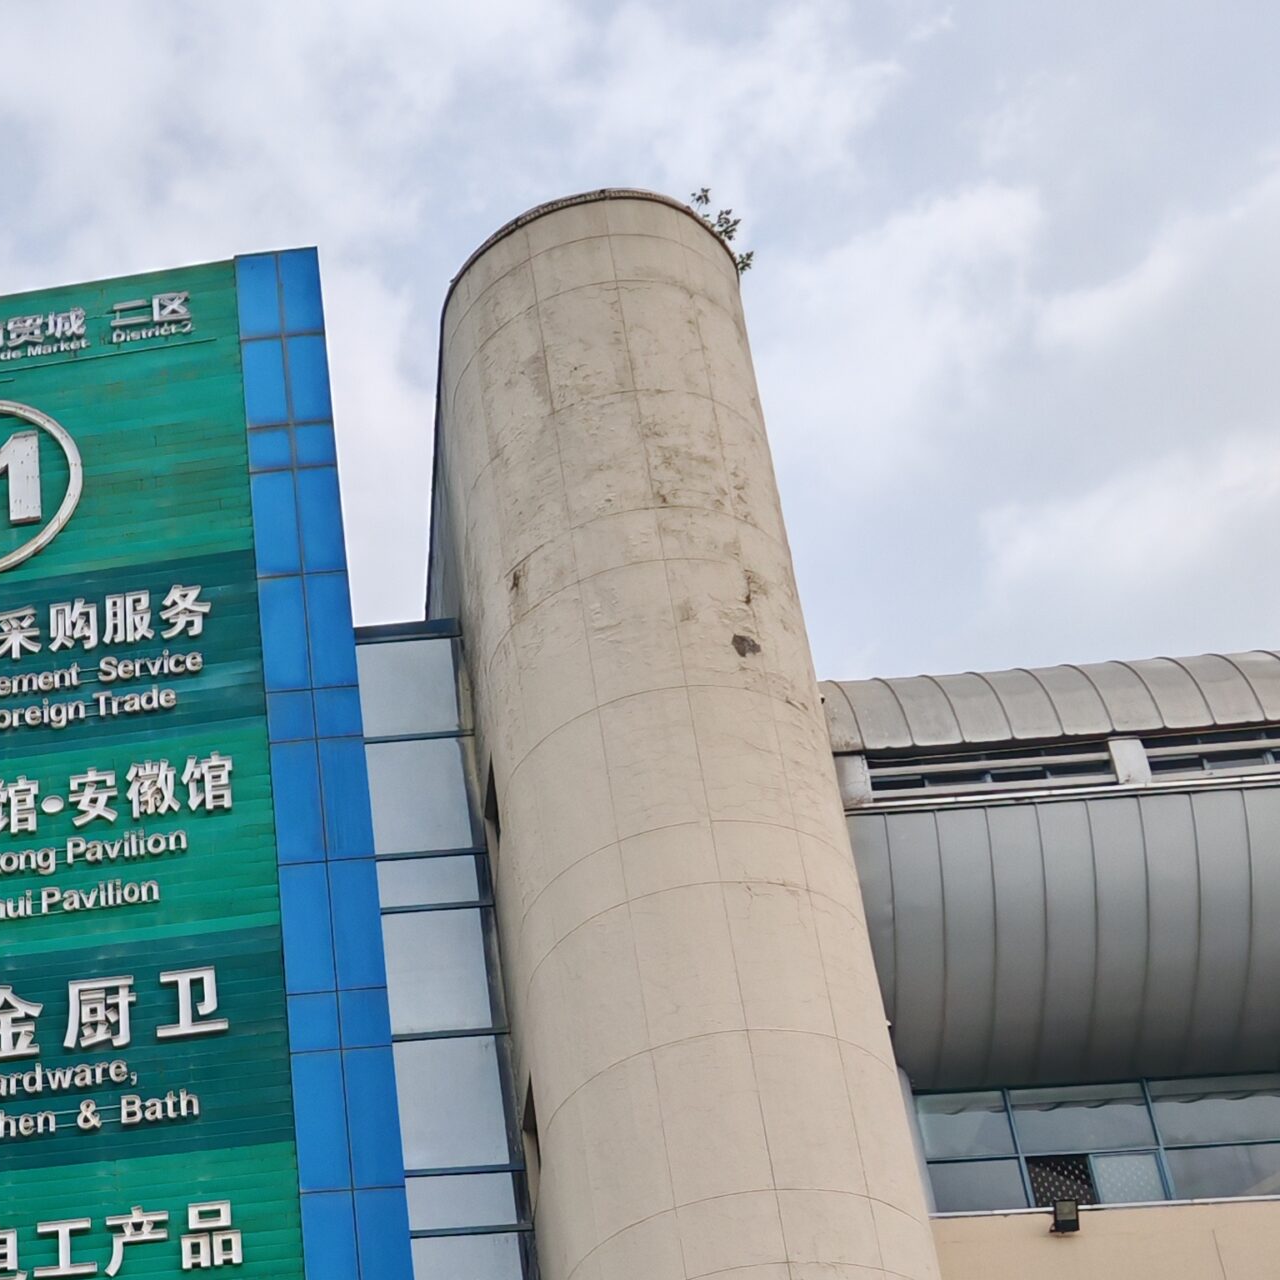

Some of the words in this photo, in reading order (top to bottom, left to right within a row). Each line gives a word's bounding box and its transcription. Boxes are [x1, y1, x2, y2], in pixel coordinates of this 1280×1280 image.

[111, 291, 192, 327] 二区
[27, 338, 88, 357] Market
[112, 325, 177, 343] District
[98, 649, 203, 682] Service
[92, 684, 177, 717] Trade
[66, 829, 187, 864] Pavilion
[41, 878, 160, 915] Pavilion
[77, 1100, 102, 1130] &
[120, 1089, 199, 1125] Bath
